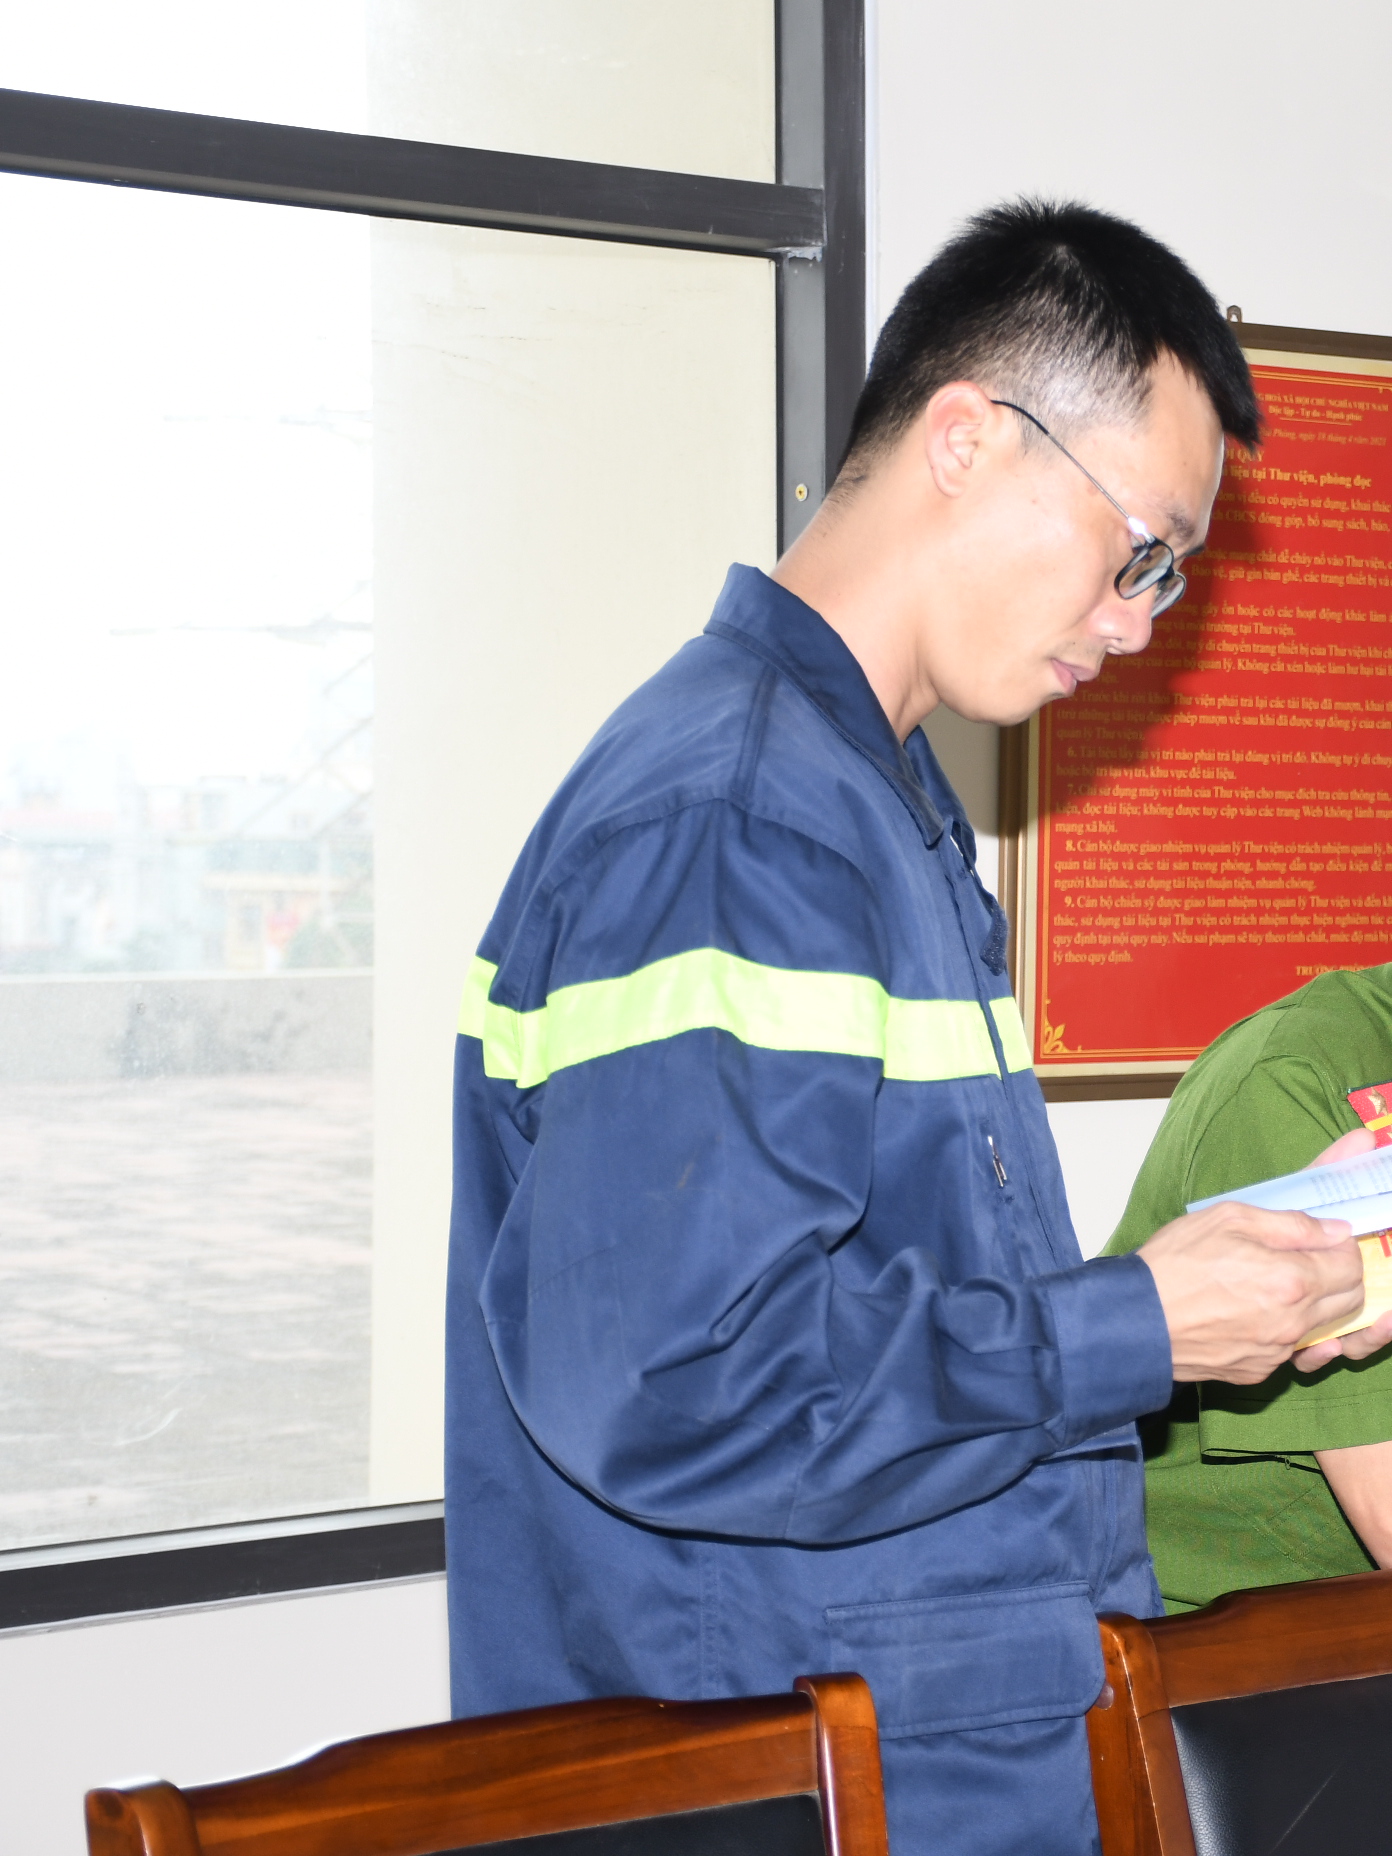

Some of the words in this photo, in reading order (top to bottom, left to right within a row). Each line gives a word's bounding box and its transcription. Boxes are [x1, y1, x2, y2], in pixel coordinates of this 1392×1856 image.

[1055, 822, 1084, 835] mạng
[1085, 820, 1097, 832] xã
[1098, 820, 1118, 835] hội.
[1054, 875, 1084, 890] người
[1085, 875, 1107, 887] khai
[1108, 875, 1133, 889] thác,
[1133, 876, 1145, 888] sử
[1146, 876, 1172, 891] dụng
[1172, 876, 1185, 888] tài
[1186, 876, 1204, 891] liệu
[1205, 876, 1232, 891] thuận
[1233, 877, 1255, 891] tiện,
[1255, 877, 1284, 889] nhanh
[1285, 877, 1317, 892] chóng.
[1064, 895, 1076, 907] 9.
[1076, 895, 1097, 907] Cán
[1099, 895, 1112, 909] bộ
[1114, 894, 1141, 907] chiến
[1143, 895, 1154, 910] sỹ
[1156, 895, 1181, 909] được
[1183, 896, 1205, 910] giao
[1207, 895, 1225, 907] làm
[1227, 895, 1257, 909] nhiệm
[1259, 898, 1271, 909] vụ
[1272, 896, 1296, 910] quản
[1297, 895, 1306, 910] lý
[1310, 895, 1328, 907] Thư
[1330, 896, 1350, 909] viện
[1352, 896, 1363, 907] và
[1363, 894, 1381, 907] đến
[1053, 913, 1079, 926] thác,
[1080, 914, 1092, 925] sử
[1094, 913, 1120, 928] dụng
[1122, 914, 1135, 925] tài
[1137, 913, 1156, 927] liệu
[1158, 914, 1171, 927] tại
[1175, 913, 1193, 925] Thư
[1196, 914, 1217, 927] viện
[1218, 914, 1231, 925] có
[1232, 913, 1257, 925] trách
[1258, 913, 1288, 927] nhiệm
[1290, 913, 1310, 927] thực
[1312, 913, 1333, 927] hiện
[1334, 913, 1369, 928] nghiêm
[1370, 914, 1384, 925] túc
[1053, 950, 1062, 965] lý
[1064, 950, 1086, 962] theo
[1087, 954, 1106, 965] quy
[1107, 950, 1134, 964] định.
